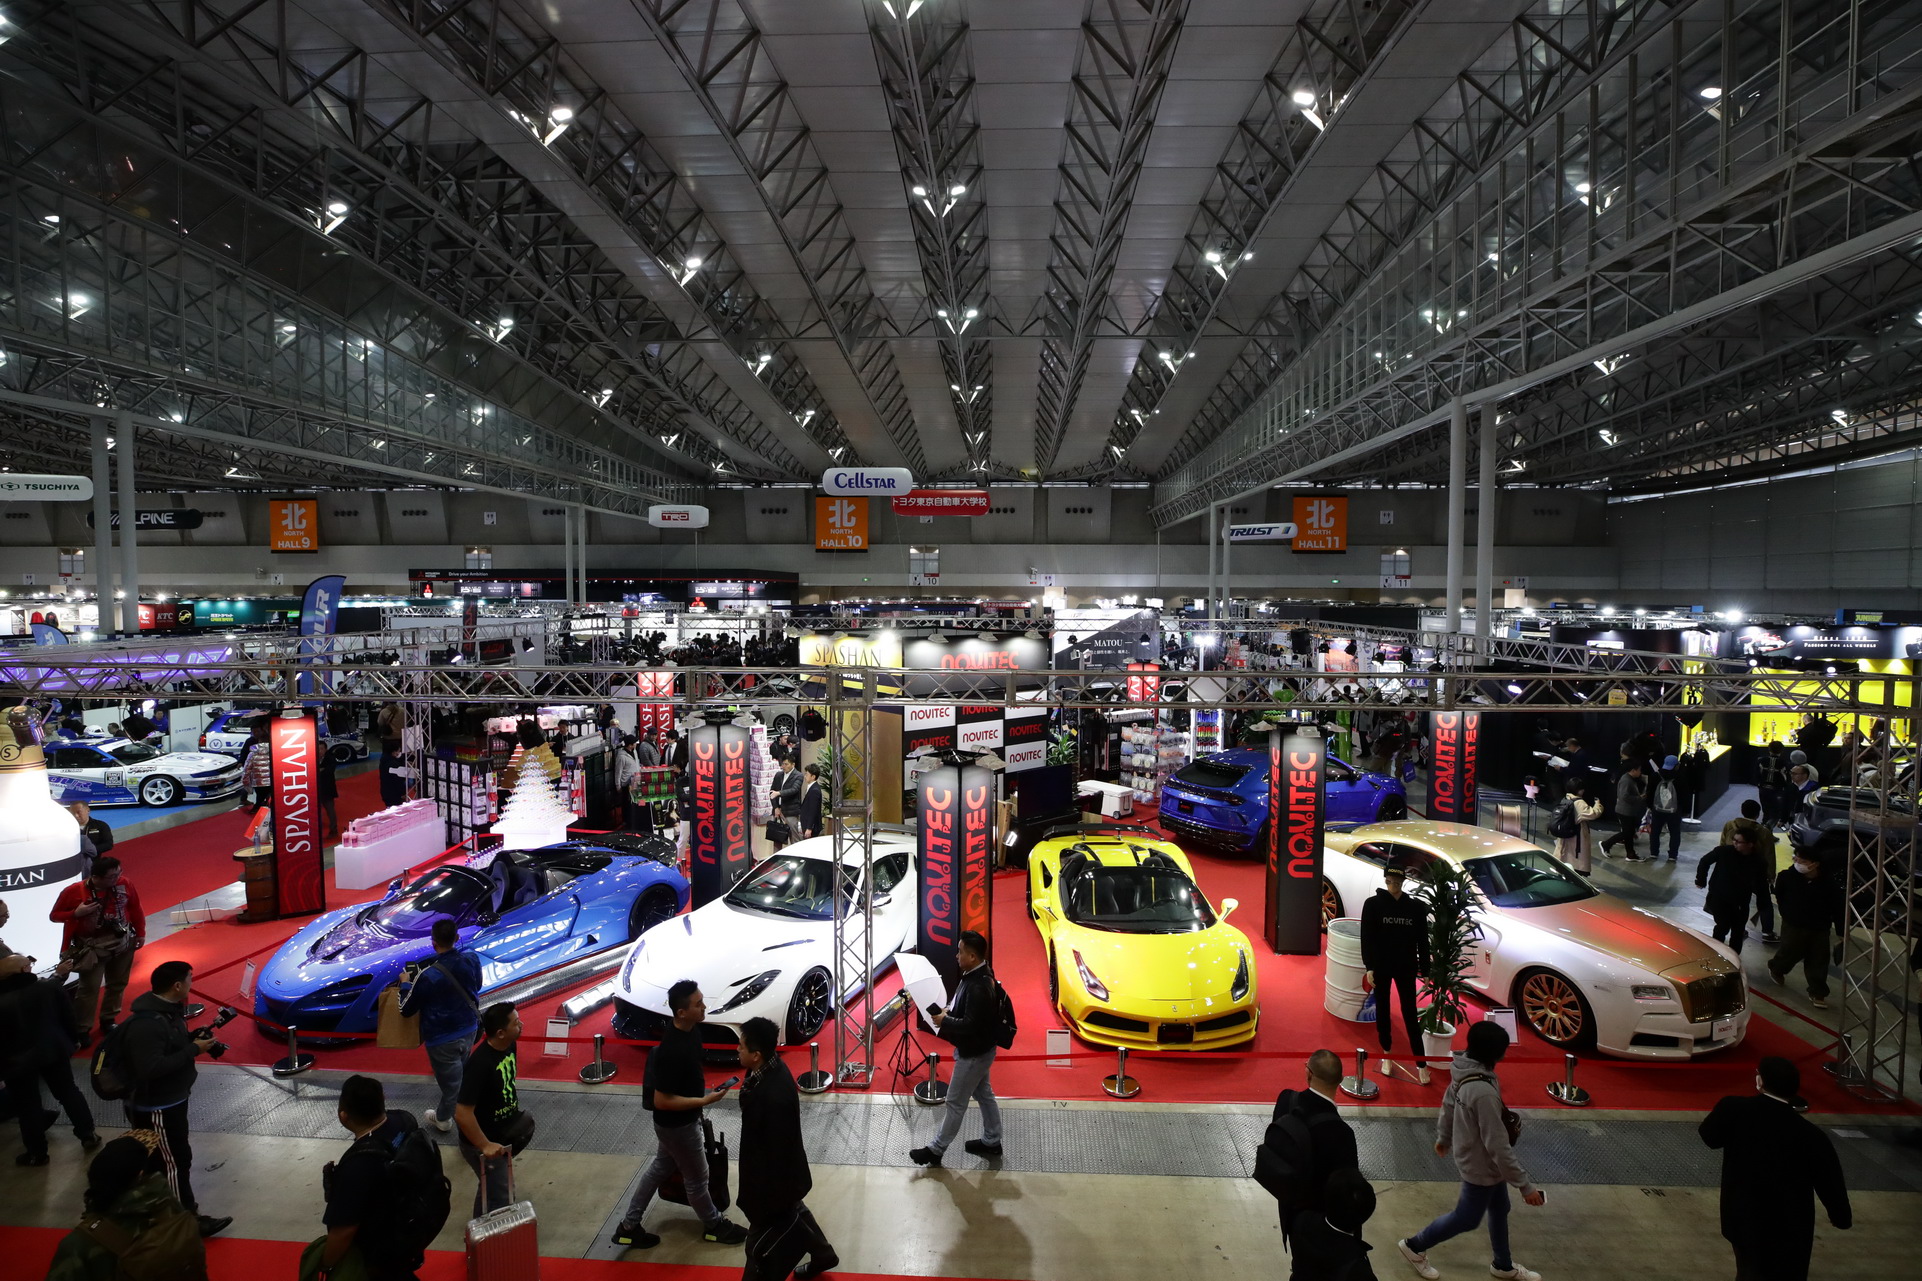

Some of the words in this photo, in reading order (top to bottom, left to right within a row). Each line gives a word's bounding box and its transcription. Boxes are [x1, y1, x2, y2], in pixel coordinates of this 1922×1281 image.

[24, 483, 81, 491] TSUCHIYA
[892, 497, 988, 507] トヨタ東京自動車大学校
[135, 513, 175, 524] LPINE
[281, 503, 307, 530] 北
[828, 499, 857, 528] 北
[1305, 499, 1336, 529] 北
[1229, 526, 1279, 537] TRUST
[301, 537, 311, 548] 9
[821, 539, 847, 548] HALL
[847, 536, 863, 548] 10
[1298, 540, 1325, 549] HALL
[1325, 536, 1340, 549] 11
[927, 577, 937, 585] 10
[1398, 579, 1408, 587] 11
[156, 612, 174, 620] KTC
[1093, 639, 1123, 647] MATOU
[814, 642, 882, 668] SPASHAN
[941, 650, 1020, 674] NOVITEC
[910, 706, 950, 721] NOVITEC
[962, 728, 999, 744] NOVITEC
[1009, 722, 1043, 737] NOVITEC
[1009, 749, 1042, 764] NOVITEC
[1434, 714, 1457, 814] NOVITEC
[1463, 715, 1478, 814] NOVITEC
[280, 728, 311, 853] SPASHAN
[695, 742, 716, 865] NOVITEC
[725, 740, 745, 862] NOVITEC
[1269, 746, 1281, 875] NOVITEC
[1287, 752, 1317, 879] NOVITEC
[1305, 780, 1316, 851] GROUP
[926, 786, 952, 946] NOVITEC
[941, 824, 951, 912] GROUP
